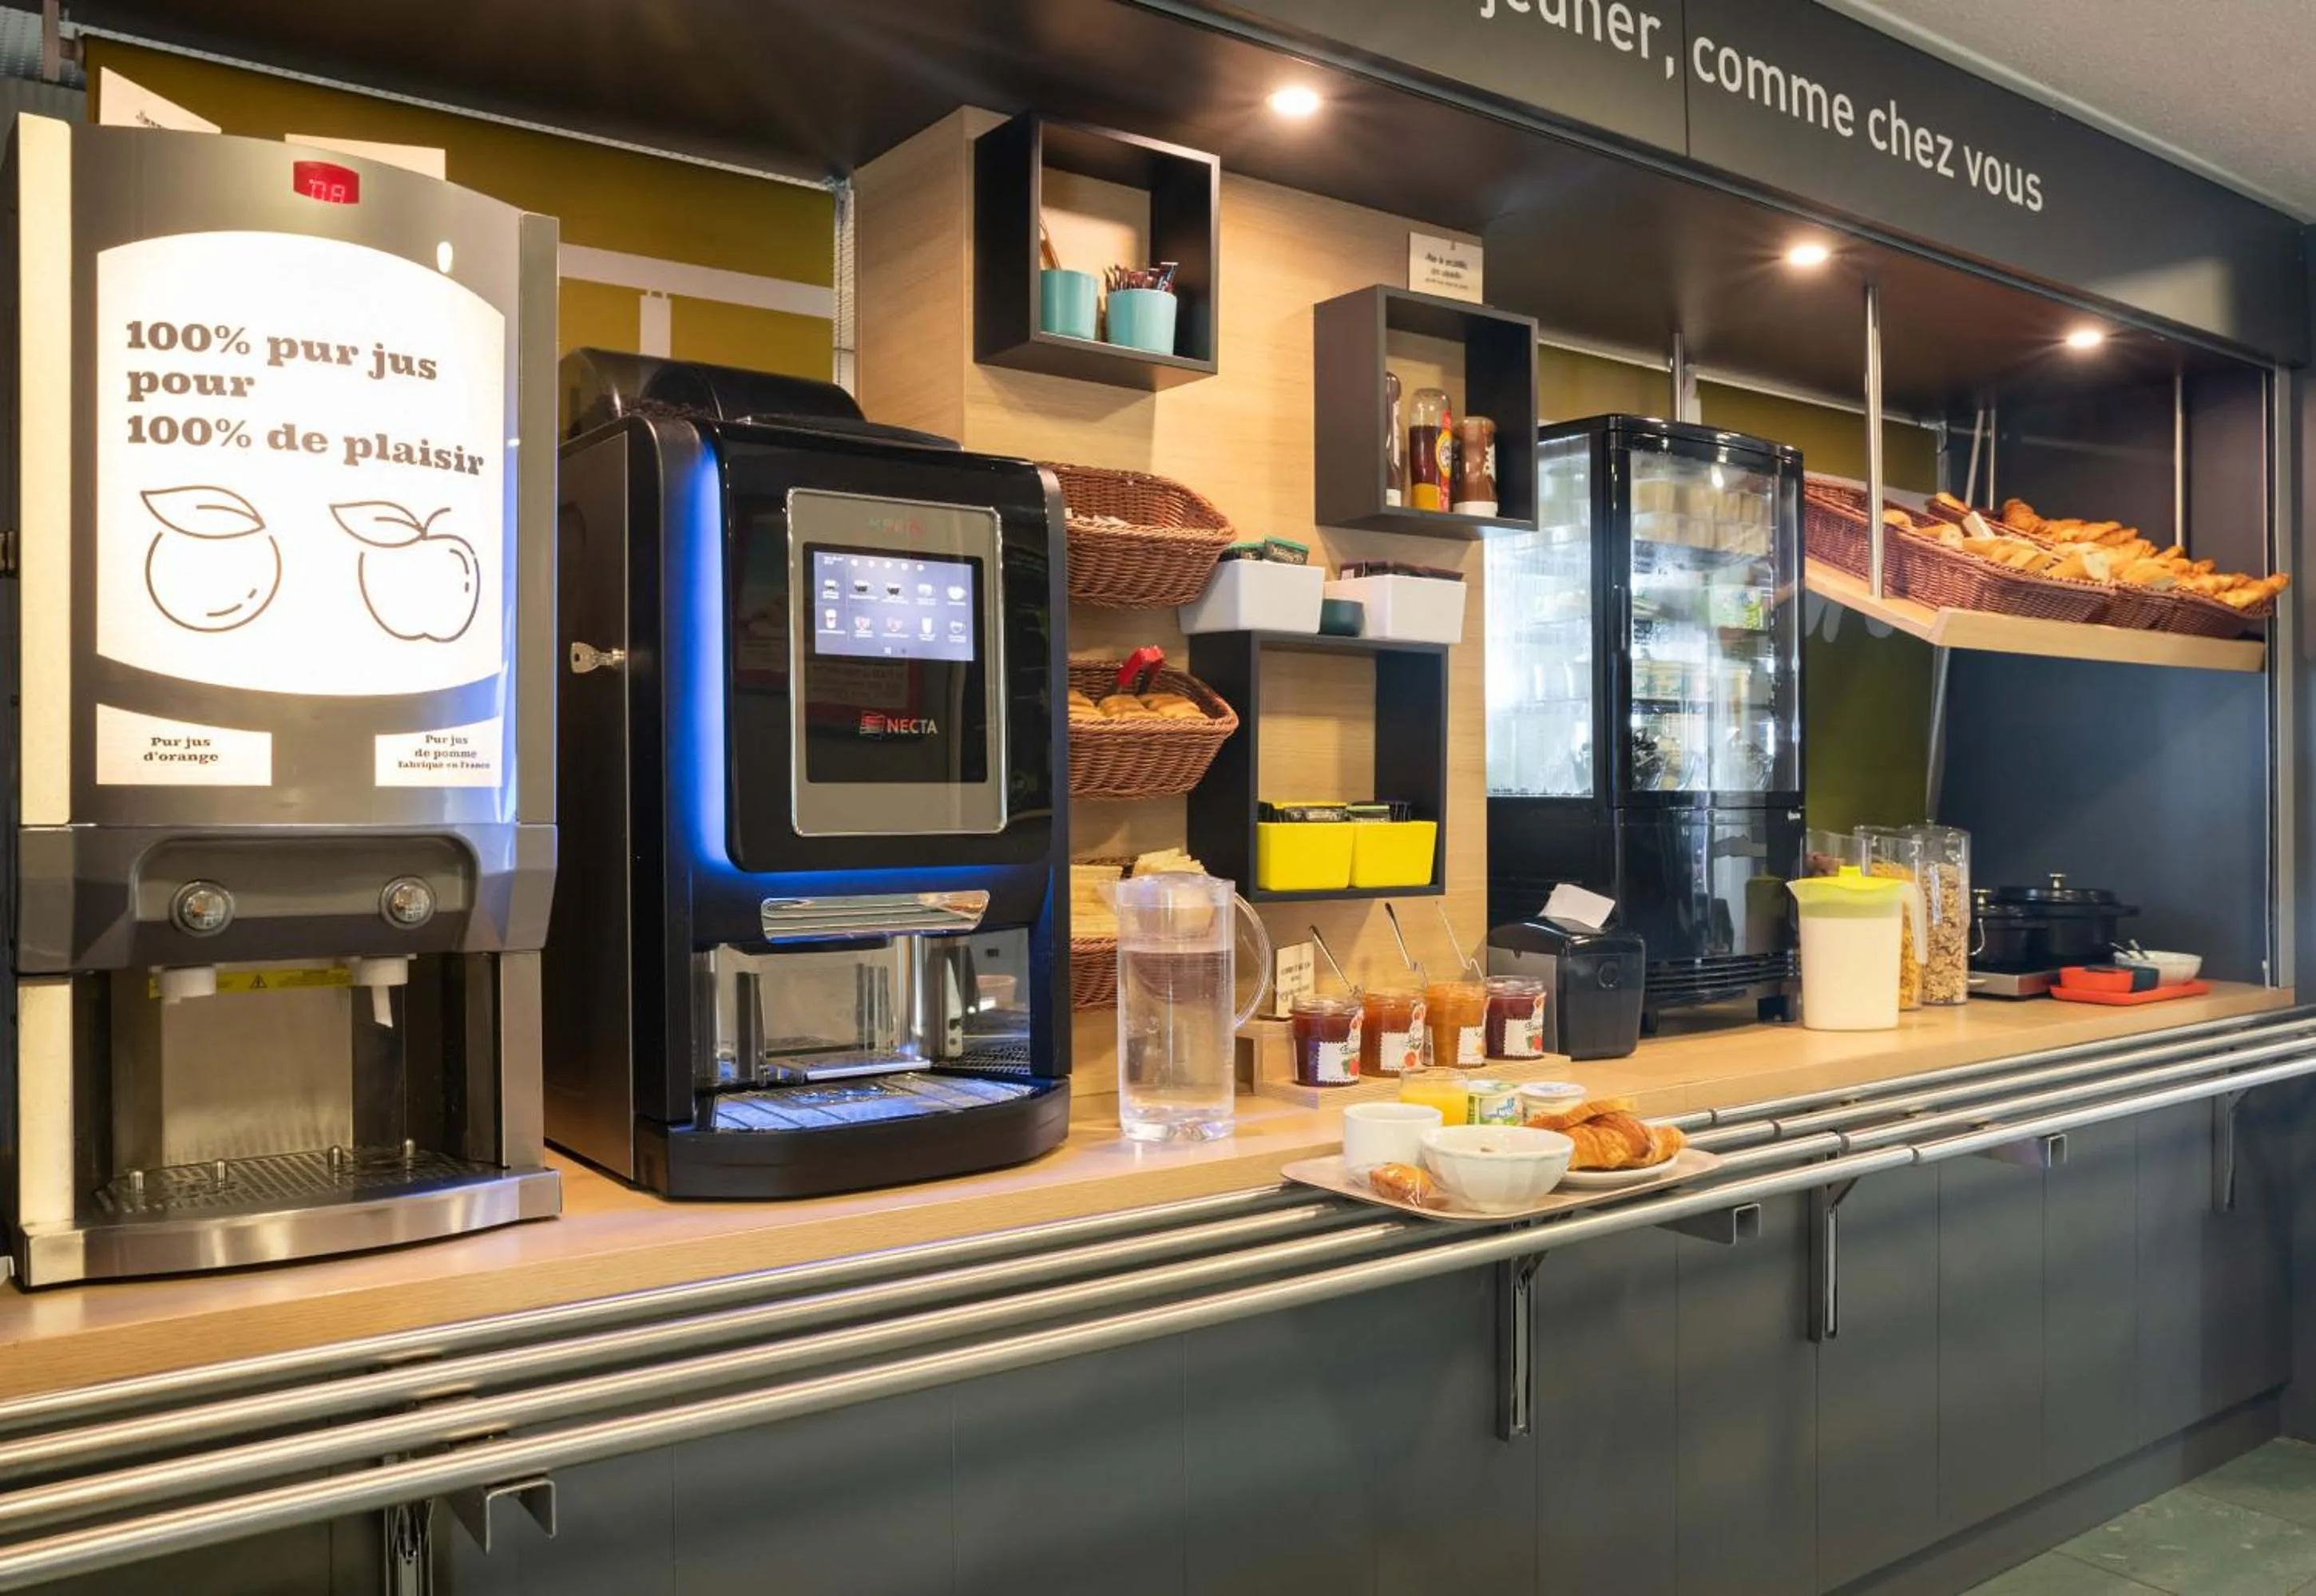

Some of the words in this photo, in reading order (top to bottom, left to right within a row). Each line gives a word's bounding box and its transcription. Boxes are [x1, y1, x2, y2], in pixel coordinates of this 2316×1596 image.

[1481, 0, 1675, 80] uner,
[1692, 37, 1855, 137] comme
[1868, 99, 1955, 179] chez
[1963, 145, 2044, 212] vous
[125, 320, 251, 355] 100%
[266, 335, 359, 367] pur
[367, 342, 438, 381] jus
[126, 370, 256, 402] pour
[127, 414, 252, 449] 100%
[267, 422, 329, 453] de
[343, 433, 485, 477] plaisir
[886, 719, 938, 735] NECTA
[149, 736, 182, 747] Pur
[184, 736, 211, 750] jus
[425, 734, 448, 745] Pur
[450, 734, 469, 747] jus
[143, 751, 219, 765] d'orange
[414, 748, 430, 758] de
[433, 750, 478, 760] pomme
